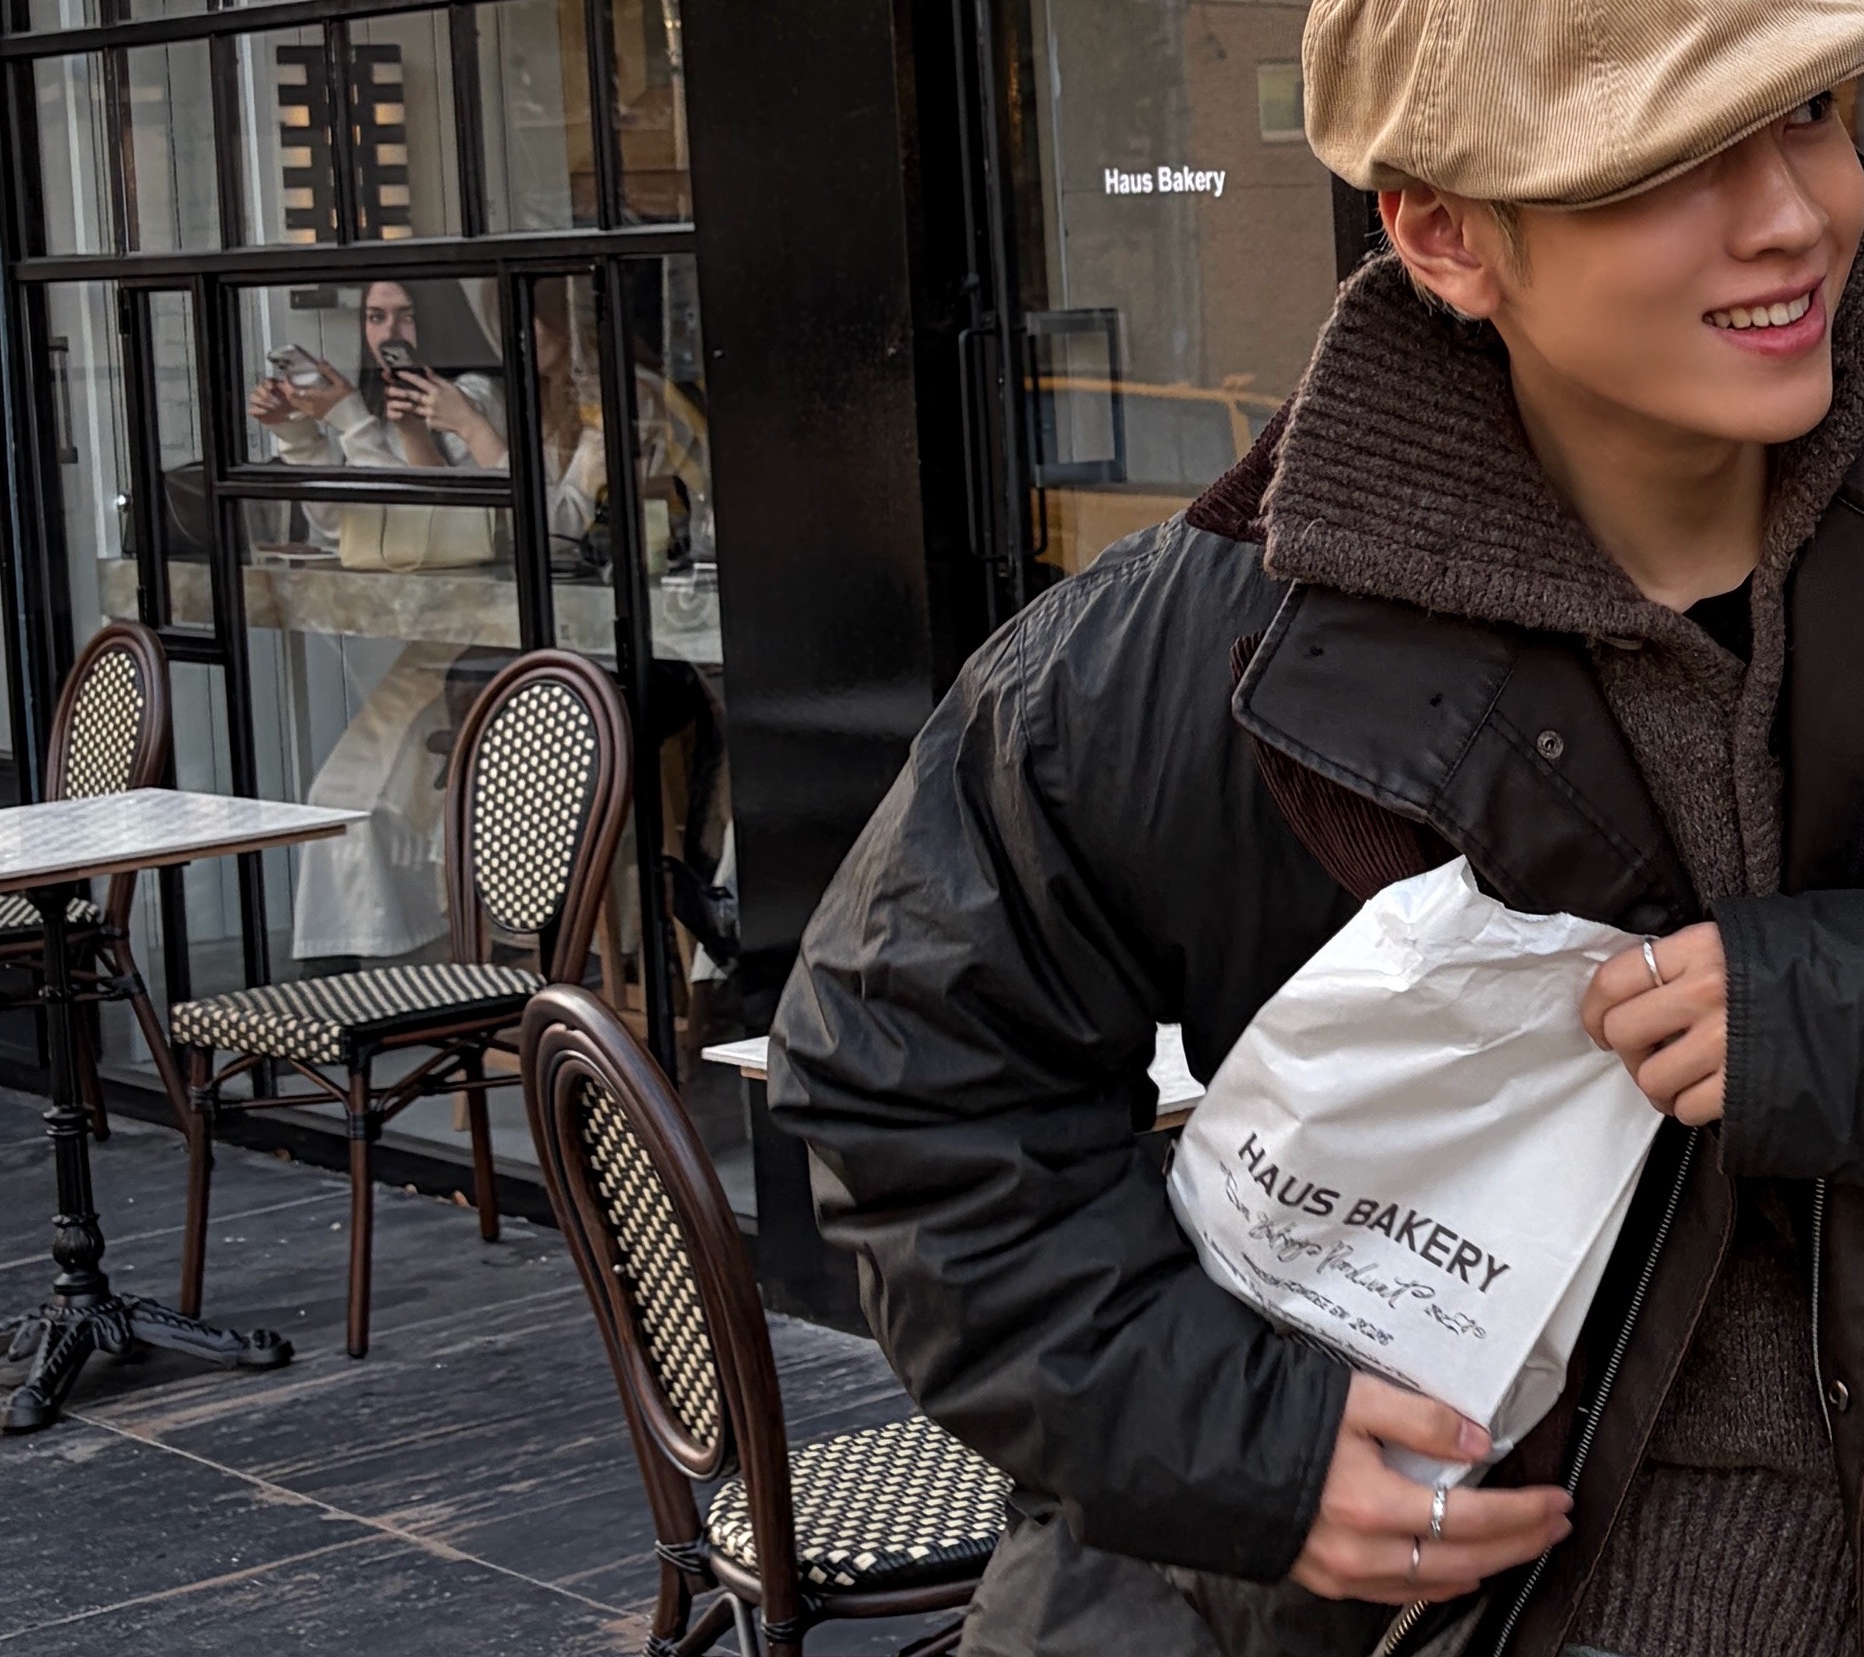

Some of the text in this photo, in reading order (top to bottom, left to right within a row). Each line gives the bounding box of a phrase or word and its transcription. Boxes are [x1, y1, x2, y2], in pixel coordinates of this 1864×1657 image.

[1104, 165, 1226, 198] Haus Bakery
[1237, 1133, 1341, 1218] HAUS
[1342, 1197, 1510, 1293] BAKERY
